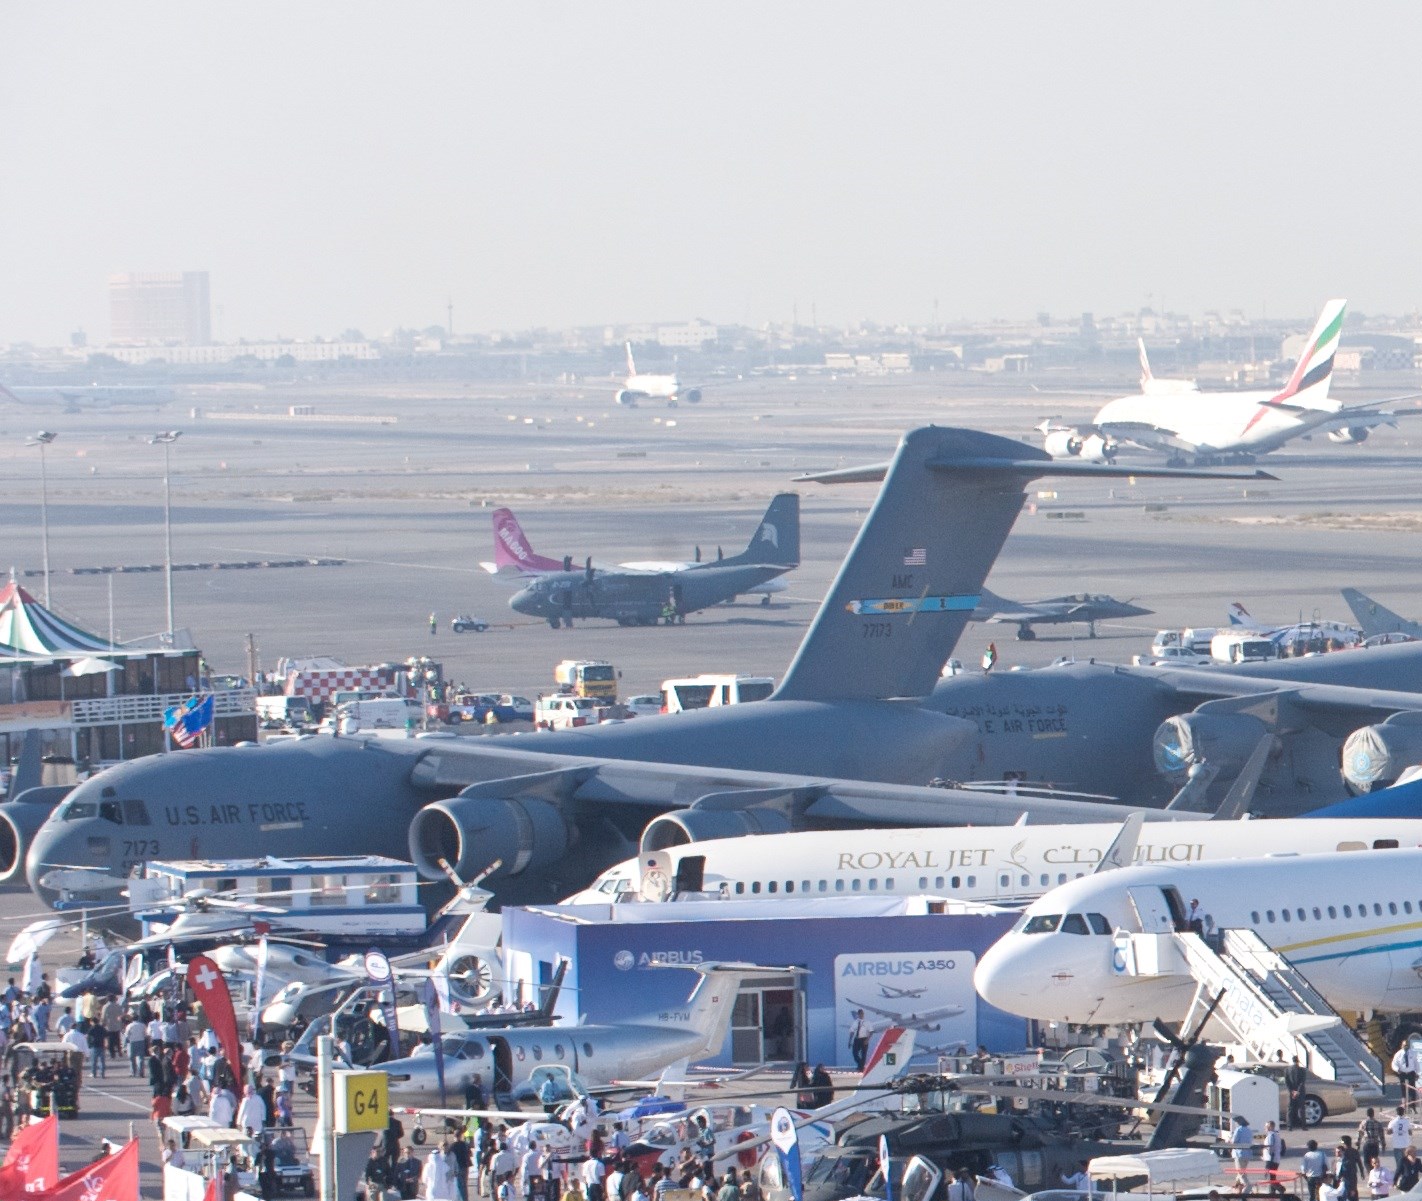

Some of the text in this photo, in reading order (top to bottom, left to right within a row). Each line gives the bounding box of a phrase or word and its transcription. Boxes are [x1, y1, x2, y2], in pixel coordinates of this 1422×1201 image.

[862, 622, 892, 637] 77173
[1003, 719, 1024, 733] AIR
[1027, 718, 1068, 733] FORCE
[165, 801, 309, 826] U.S. AIR FORCE
[122, 840, 160, 856] 7173
[838, 848, 994, 871] ROYAL JET
[639, 951, 704, 970] AIRBUS
[842, 960, 956, 977] AIRBUS A350
[354, 1088, 379, 1115] G4
